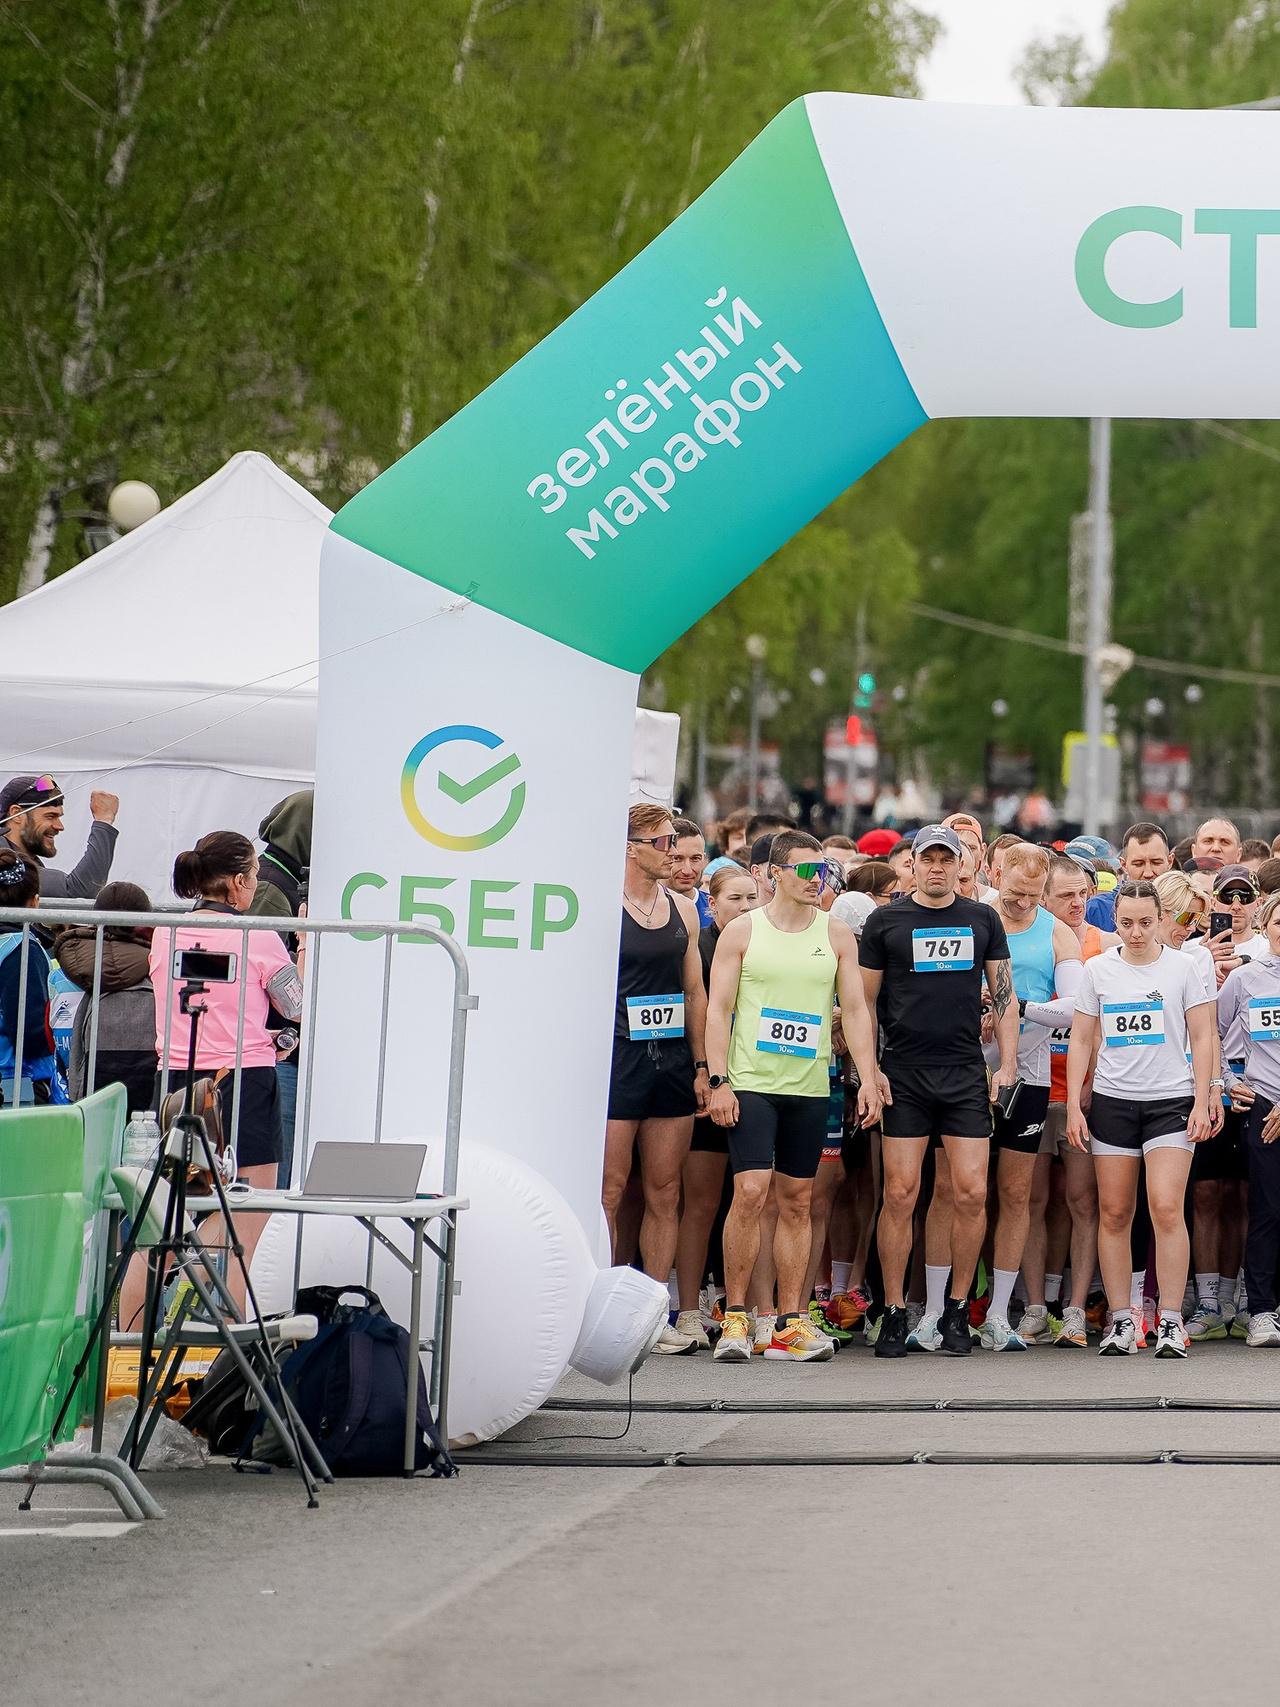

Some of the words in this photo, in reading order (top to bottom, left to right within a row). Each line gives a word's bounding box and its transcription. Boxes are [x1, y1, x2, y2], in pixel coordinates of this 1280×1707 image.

[526, 285, 763, 514] зелёный
[564, 341, 804, 560] марафон
[341, 871, 579, 951] СБЕР
[925, 939, 962, 958] 767
[640, 1007, 674, 1026] 807
[1037, 1006, 1065, 1016] DEMIX
[770, 1022, 808, 1043] 803
[1116, 1014, 1152, 1033] 848
